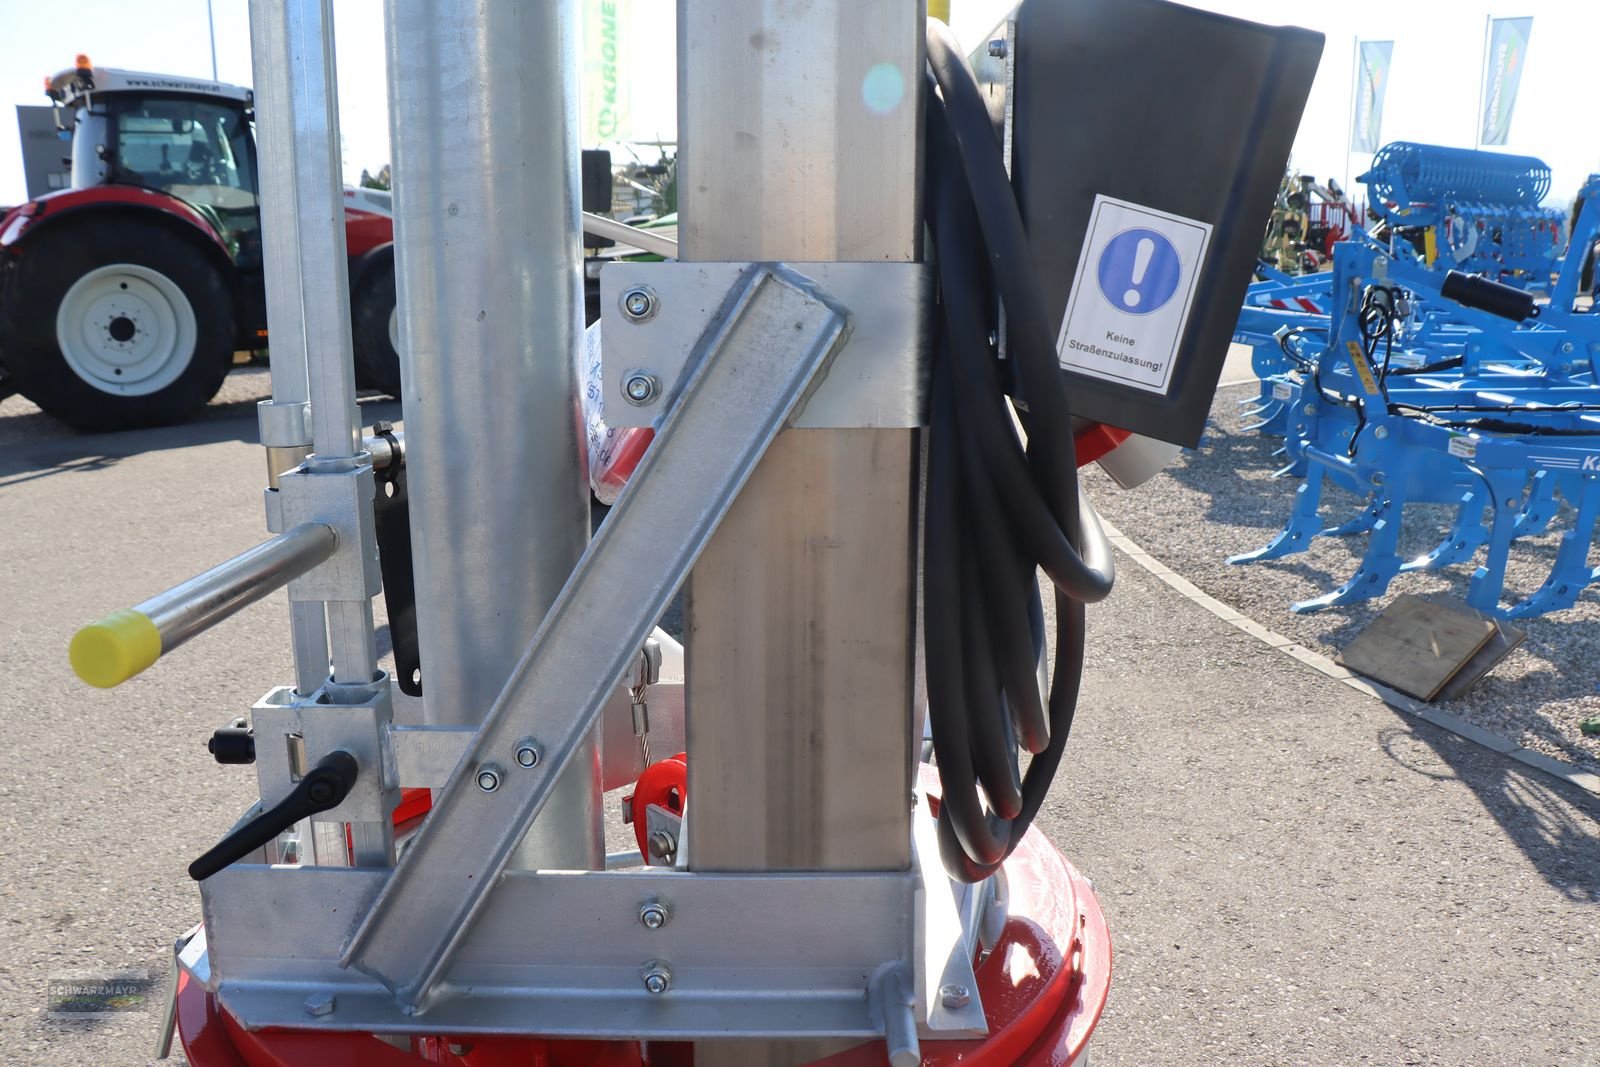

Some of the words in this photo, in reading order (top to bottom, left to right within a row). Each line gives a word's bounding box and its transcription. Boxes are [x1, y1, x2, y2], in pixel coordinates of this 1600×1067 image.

[601, 0, 617, 105] KRONE
[1106, 330, 1136, 347] Keine
[1068, 339, 1163, 372] Straßenzulassung!
